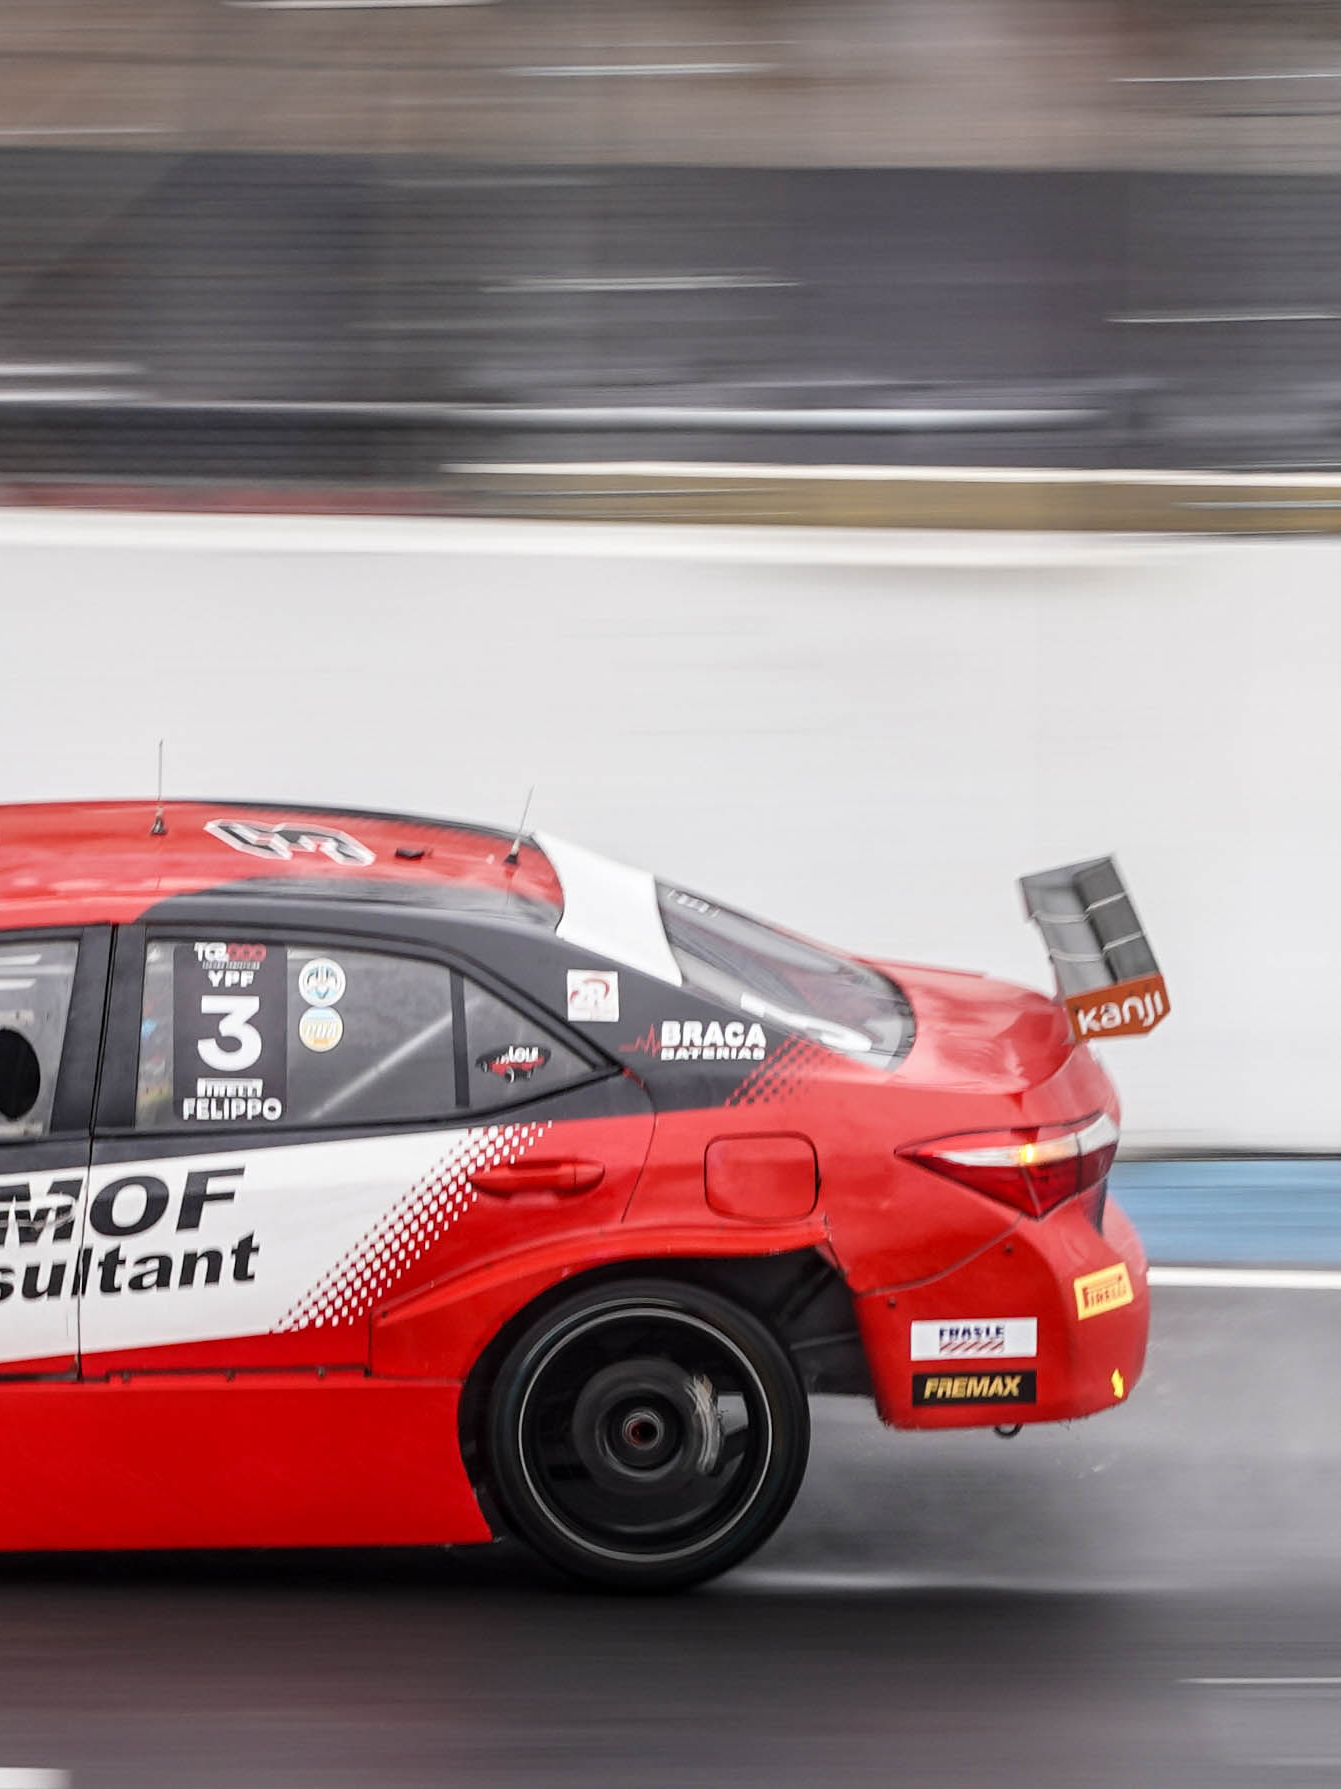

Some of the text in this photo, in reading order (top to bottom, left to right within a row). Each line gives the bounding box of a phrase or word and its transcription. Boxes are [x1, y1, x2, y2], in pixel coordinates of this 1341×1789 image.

[209, 970, 254, 987] YPF
[1077, 990, 1164, 1036] kanji
[198, 995, 262, 1071] 3
[661, 1020, 767, 1048] BRACA
[183, 1098, 282, 1121] FELIPPO
[924, 1374, 1022, 1399] FREMAX
